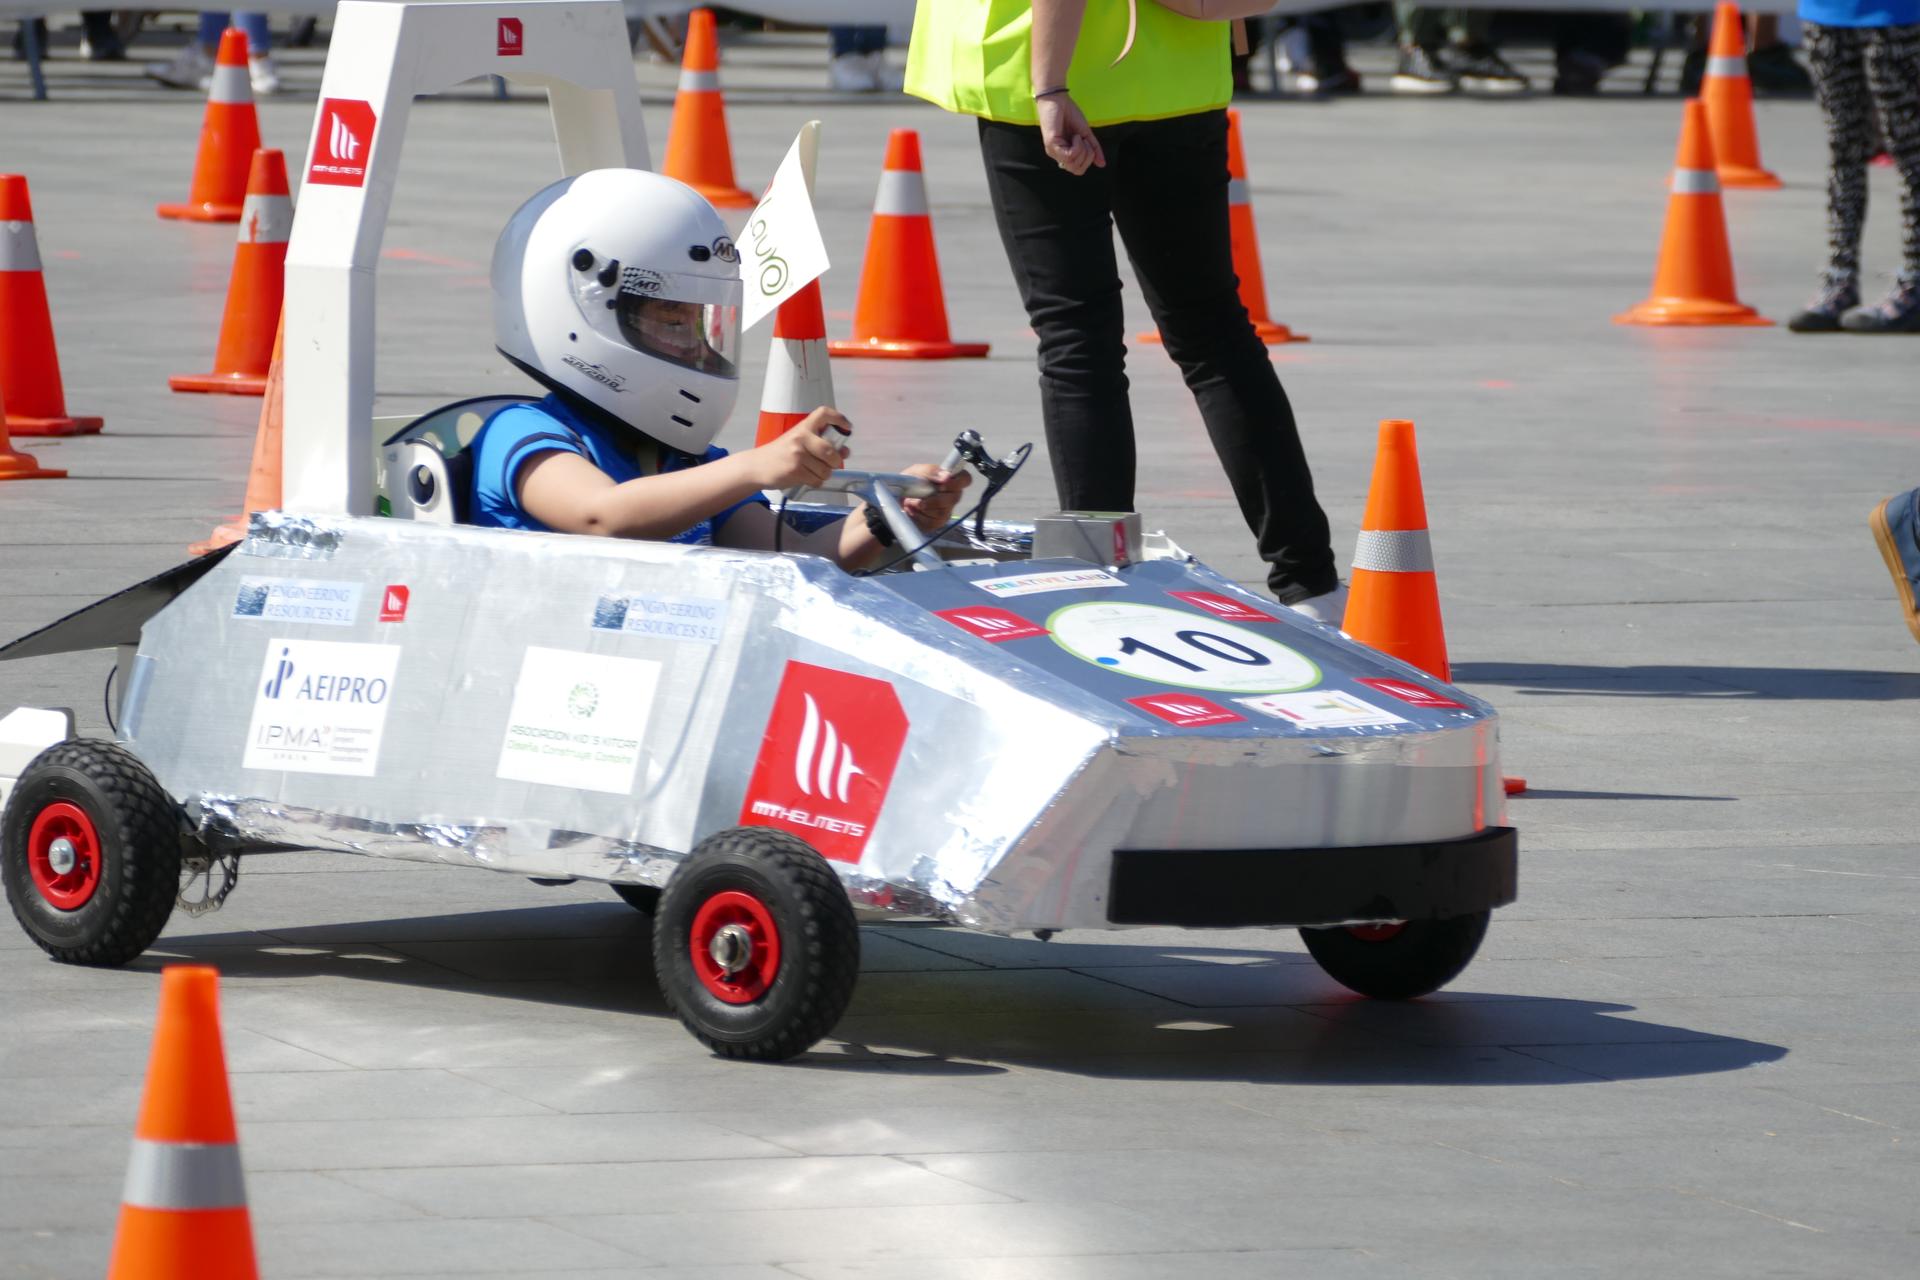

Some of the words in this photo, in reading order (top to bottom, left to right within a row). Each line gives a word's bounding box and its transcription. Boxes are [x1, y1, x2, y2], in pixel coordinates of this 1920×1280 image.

[269, 585, 350, 603] ENGINEERING
[267, 604, 333, 620] RESOURCES
[631, 599, 716, 619] ENGINEERING
[627, 618, 698, 638] RESOURCES
[1118, 630, 1272, 672] 10
[296, 674, 388, 704] AEIPRO
[256, 723, 323, 747] IPMA
